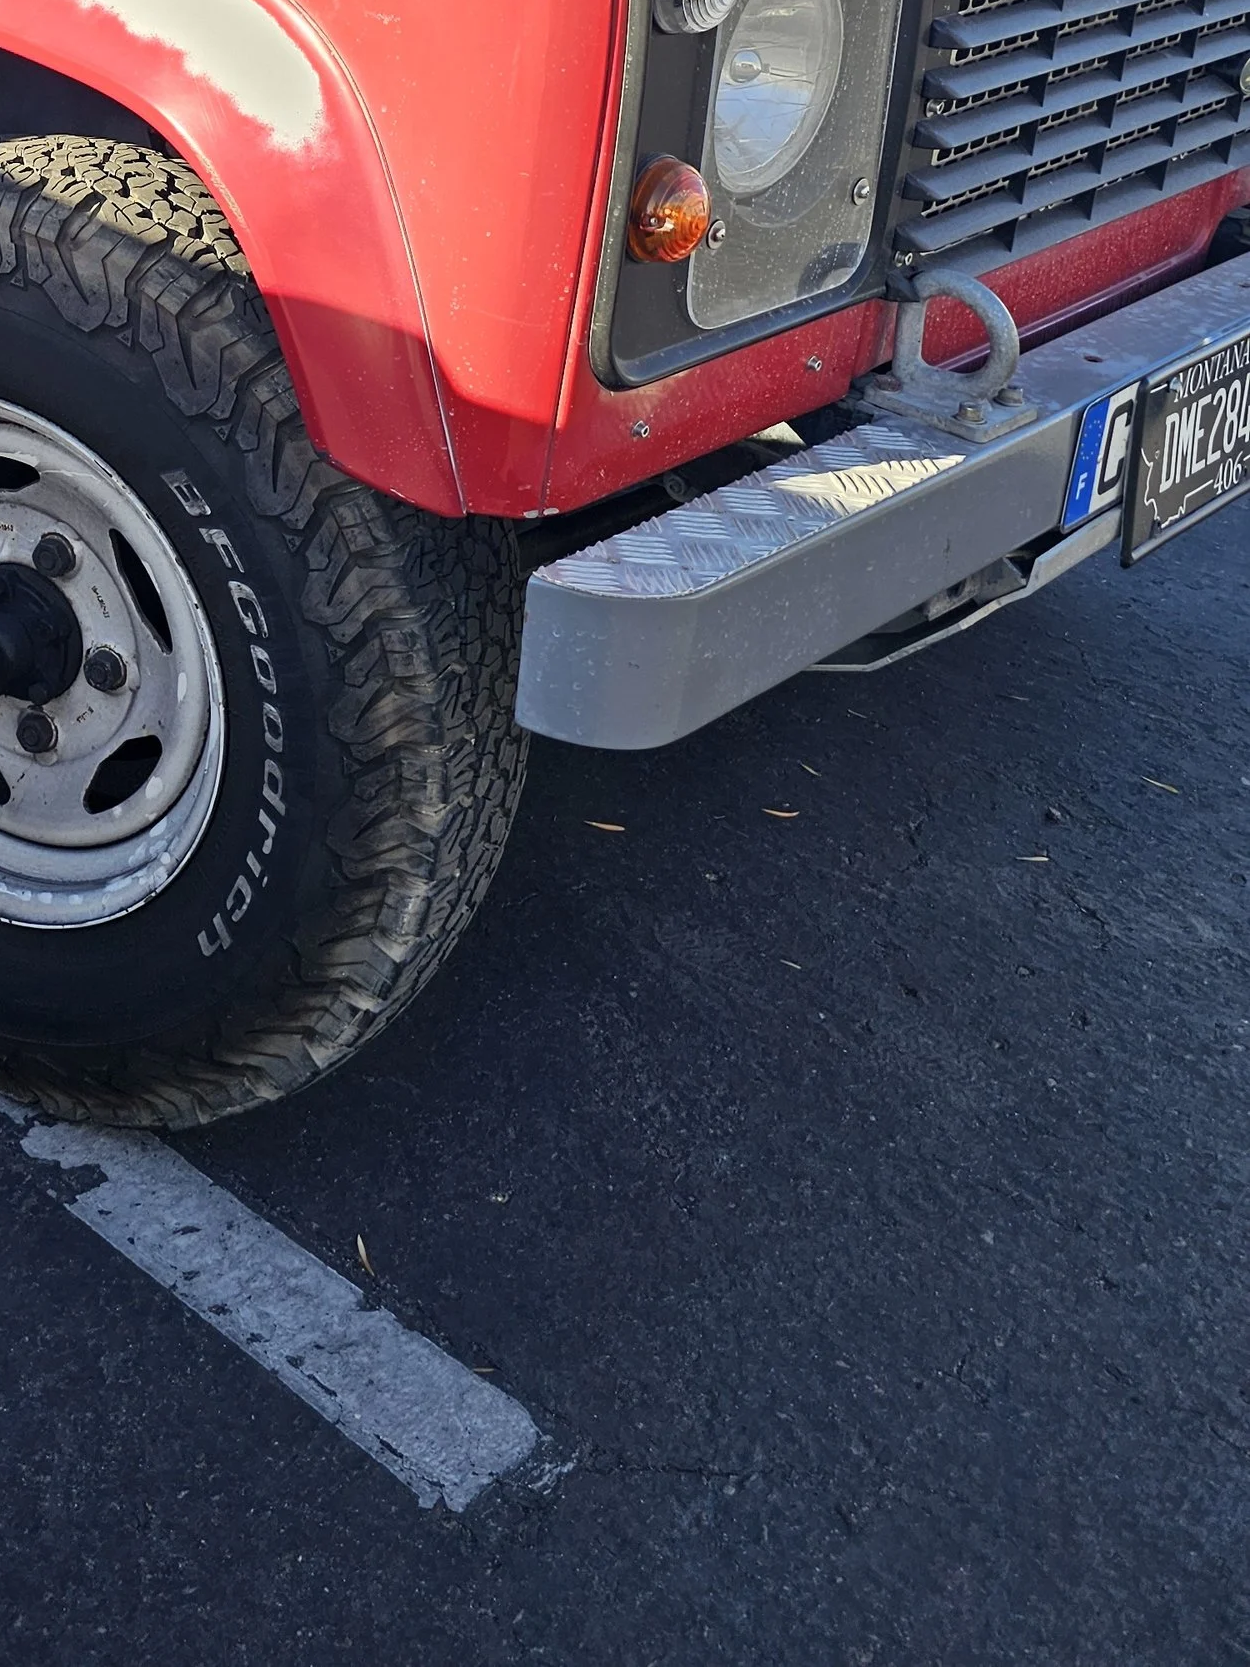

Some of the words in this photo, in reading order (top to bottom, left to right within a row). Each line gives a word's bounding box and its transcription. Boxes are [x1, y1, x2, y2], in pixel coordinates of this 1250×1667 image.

[1174, 338, 1250, 402] MONTANA
[1075, 472, 1088, 501] F
[1213, 451, 1244, 495] 406
[160, 468, 286, 958] BFGoodrich
